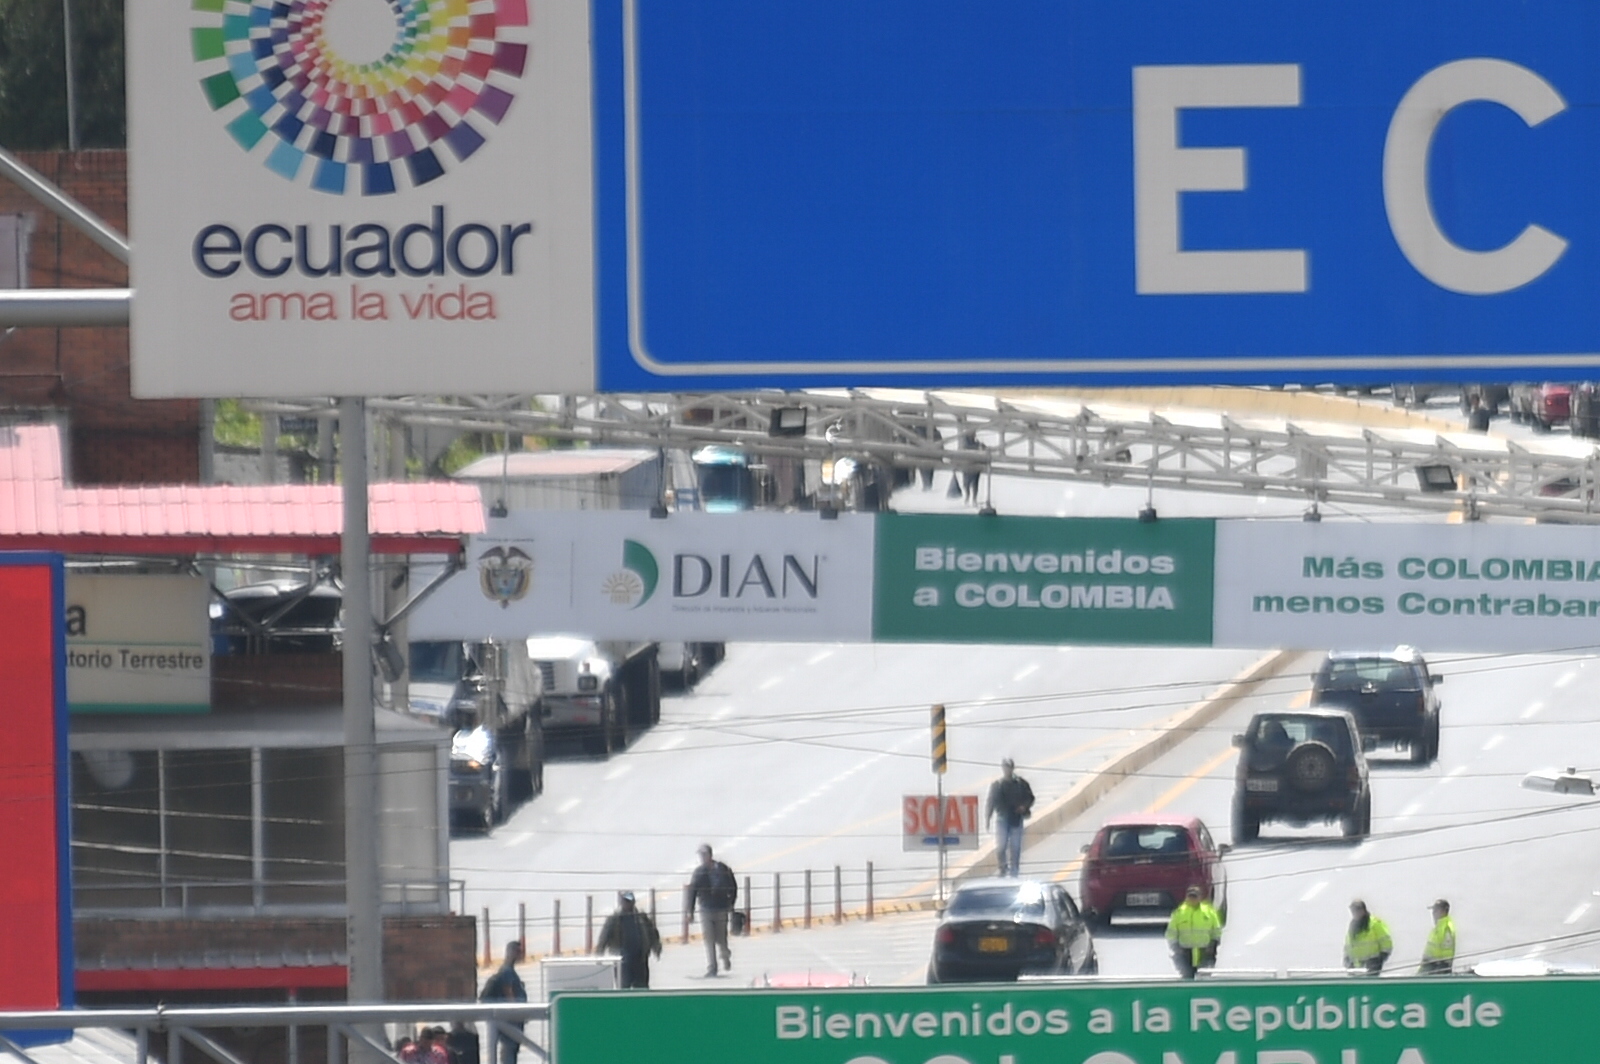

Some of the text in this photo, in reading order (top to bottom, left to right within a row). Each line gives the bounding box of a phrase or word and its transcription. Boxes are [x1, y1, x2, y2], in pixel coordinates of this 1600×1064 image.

[192, 204, 532, 279] ecuador
[229, 283, 498, 323] ama la vida
[673, 553, 819, 599] DIAN
[913, 546, 1176, 577] Bienvenidos
[1302, 554, 1386, 581] Más
[912, 583, 1175, 612] a COLOMBIA
[1251, 594, 1386, 616] menos
[66, 649, 203, 670] torio Terrestre
[904, 794, 979, 835] SOAT
[774, 995, 1504, 1041] Bienvenidos a la República de
